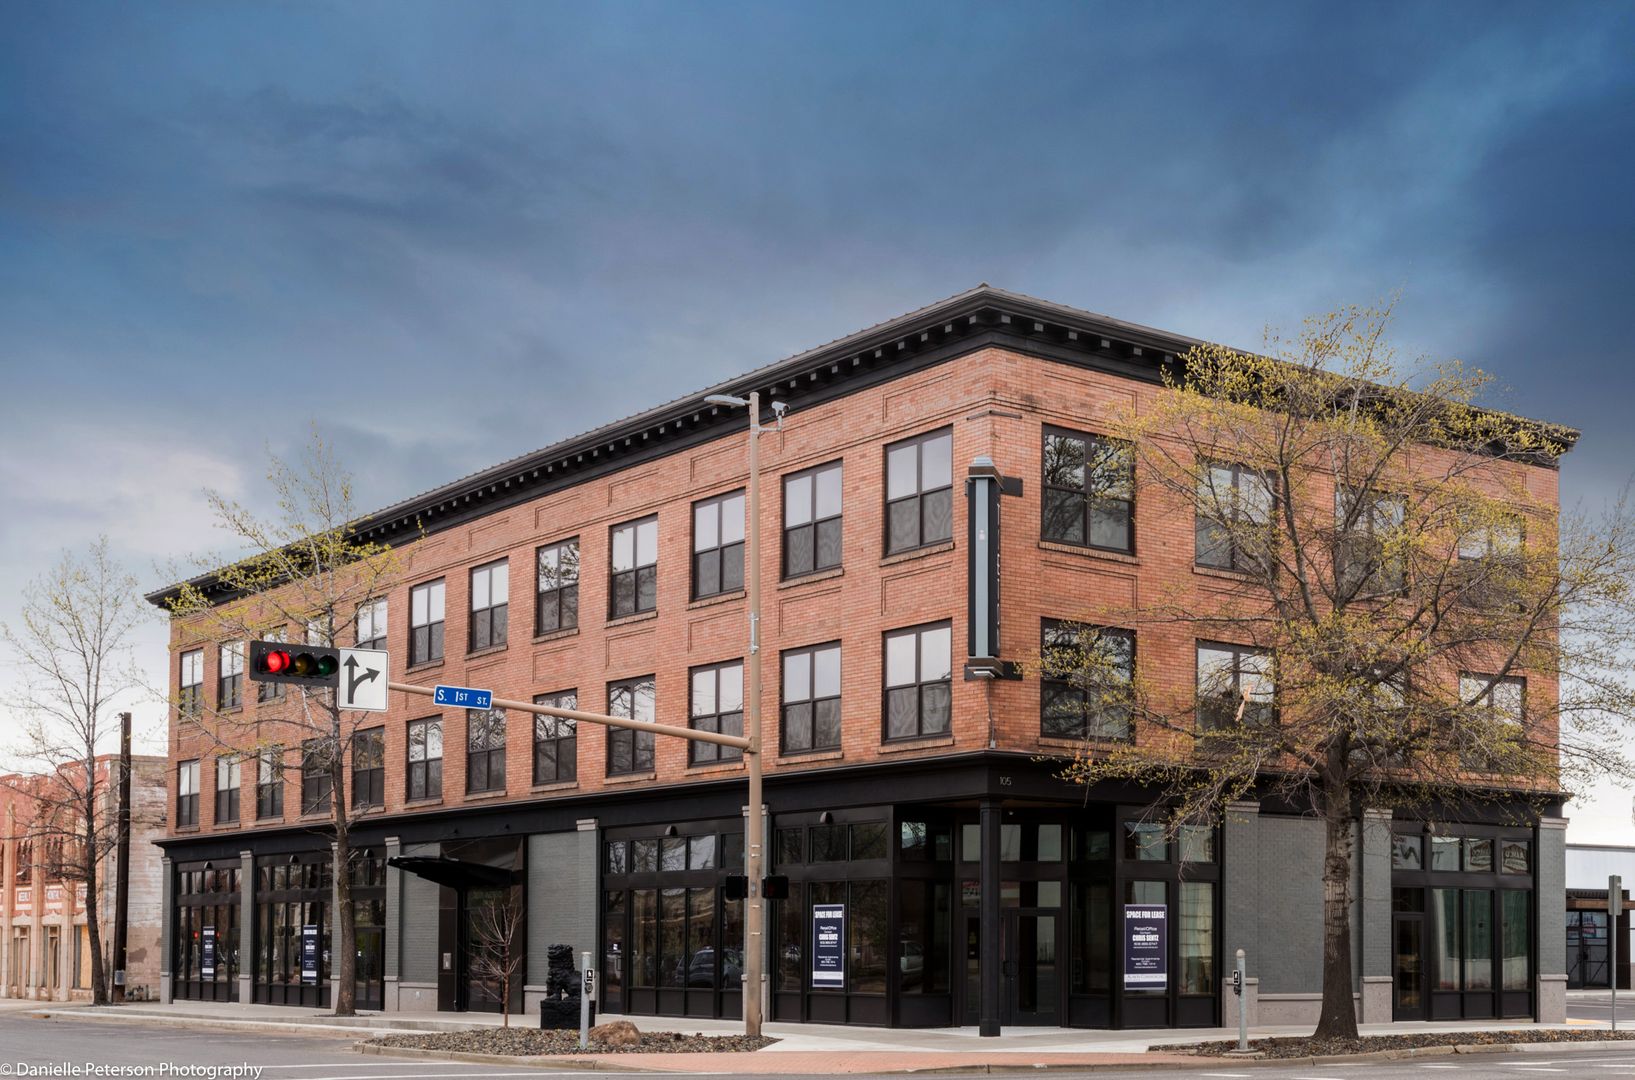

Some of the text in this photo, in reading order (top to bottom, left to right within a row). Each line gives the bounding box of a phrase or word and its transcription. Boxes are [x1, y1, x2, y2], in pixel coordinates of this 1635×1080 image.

[437, 689, 488, 706] S. 1ST ST.
[999, 776, 1012, 786] 105
[1126, 910, 1165, 919] SPACE FOR LEASE
